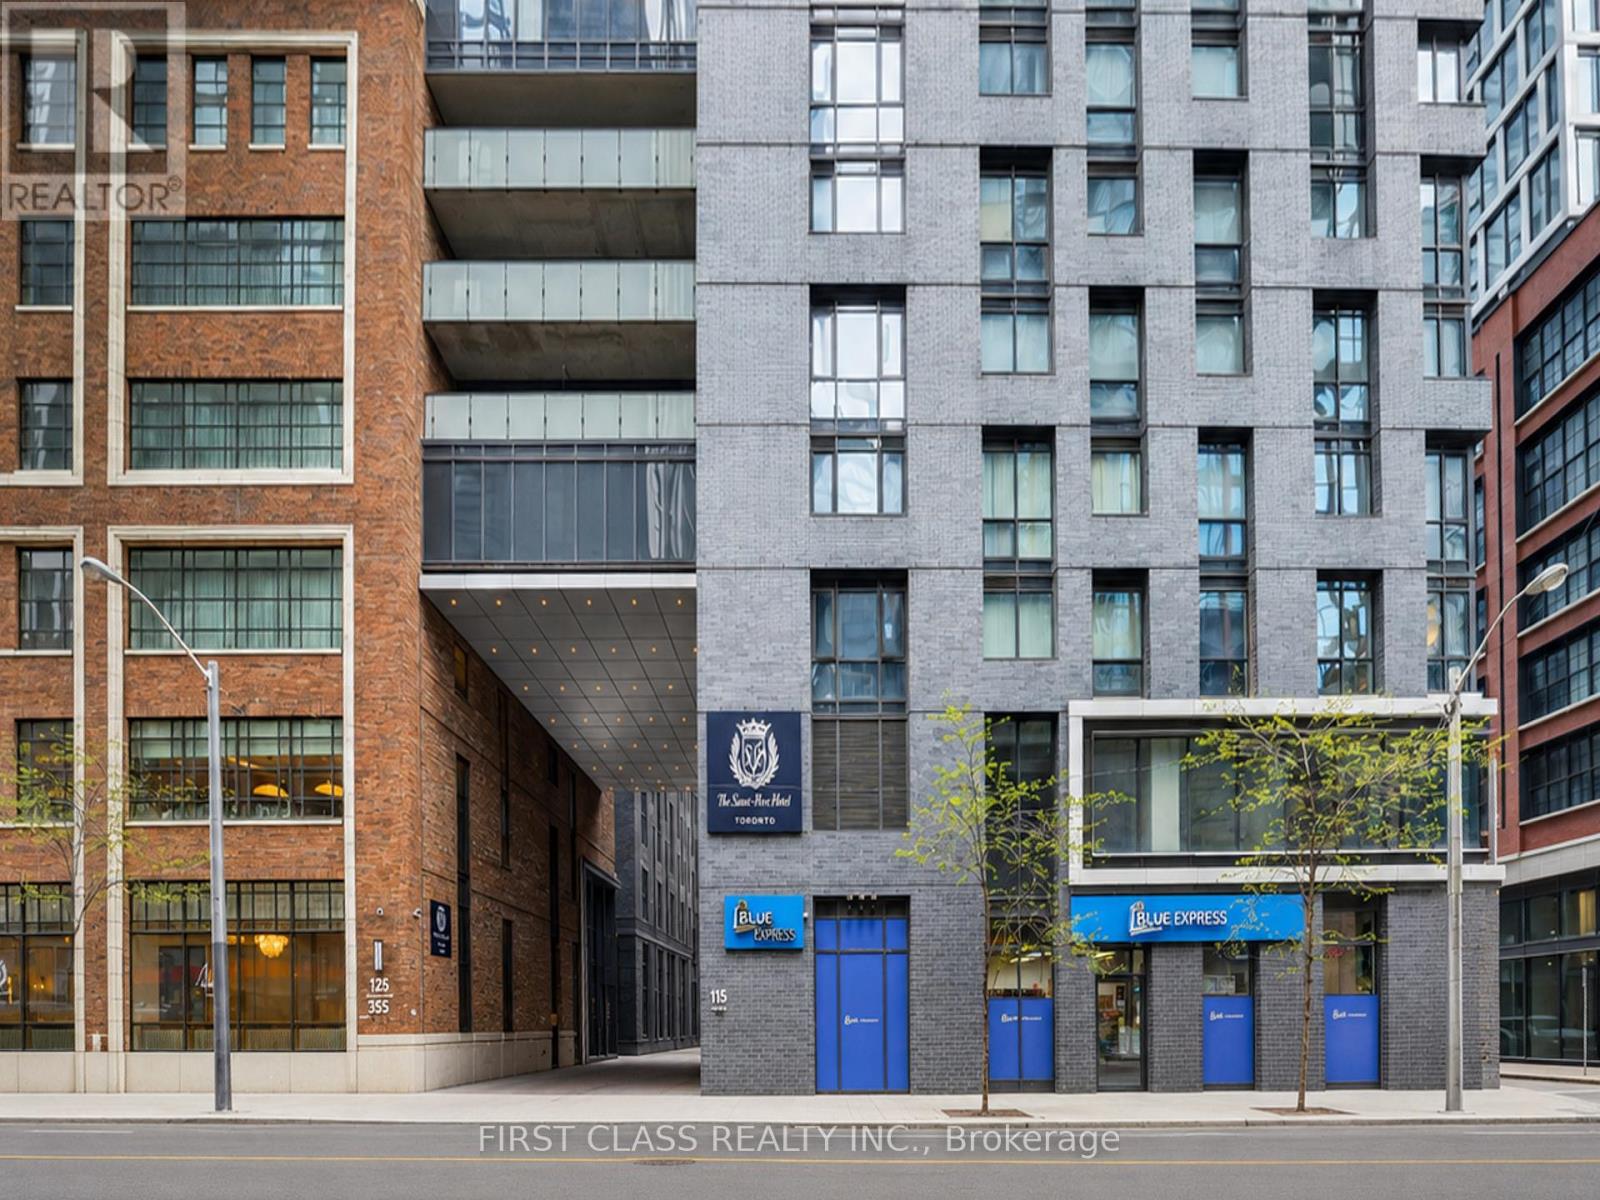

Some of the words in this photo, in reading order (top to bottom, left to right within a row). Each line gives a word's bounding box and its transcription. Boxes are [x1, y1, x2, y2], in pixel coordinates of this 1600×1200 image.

[735, 816, 776, 825] TORONTO
[739, 911, 773, 925] BLUE
[1136, 911, 1171, 926] BLUE
[1174, 910, 1228, 926] EXPRESS
[754, 927, 796, 941] EXPRESS
[370, 977, 389, 993] 125
[710, 989, 728, 1004] 115
[368, 999, 389, 1014] 355
